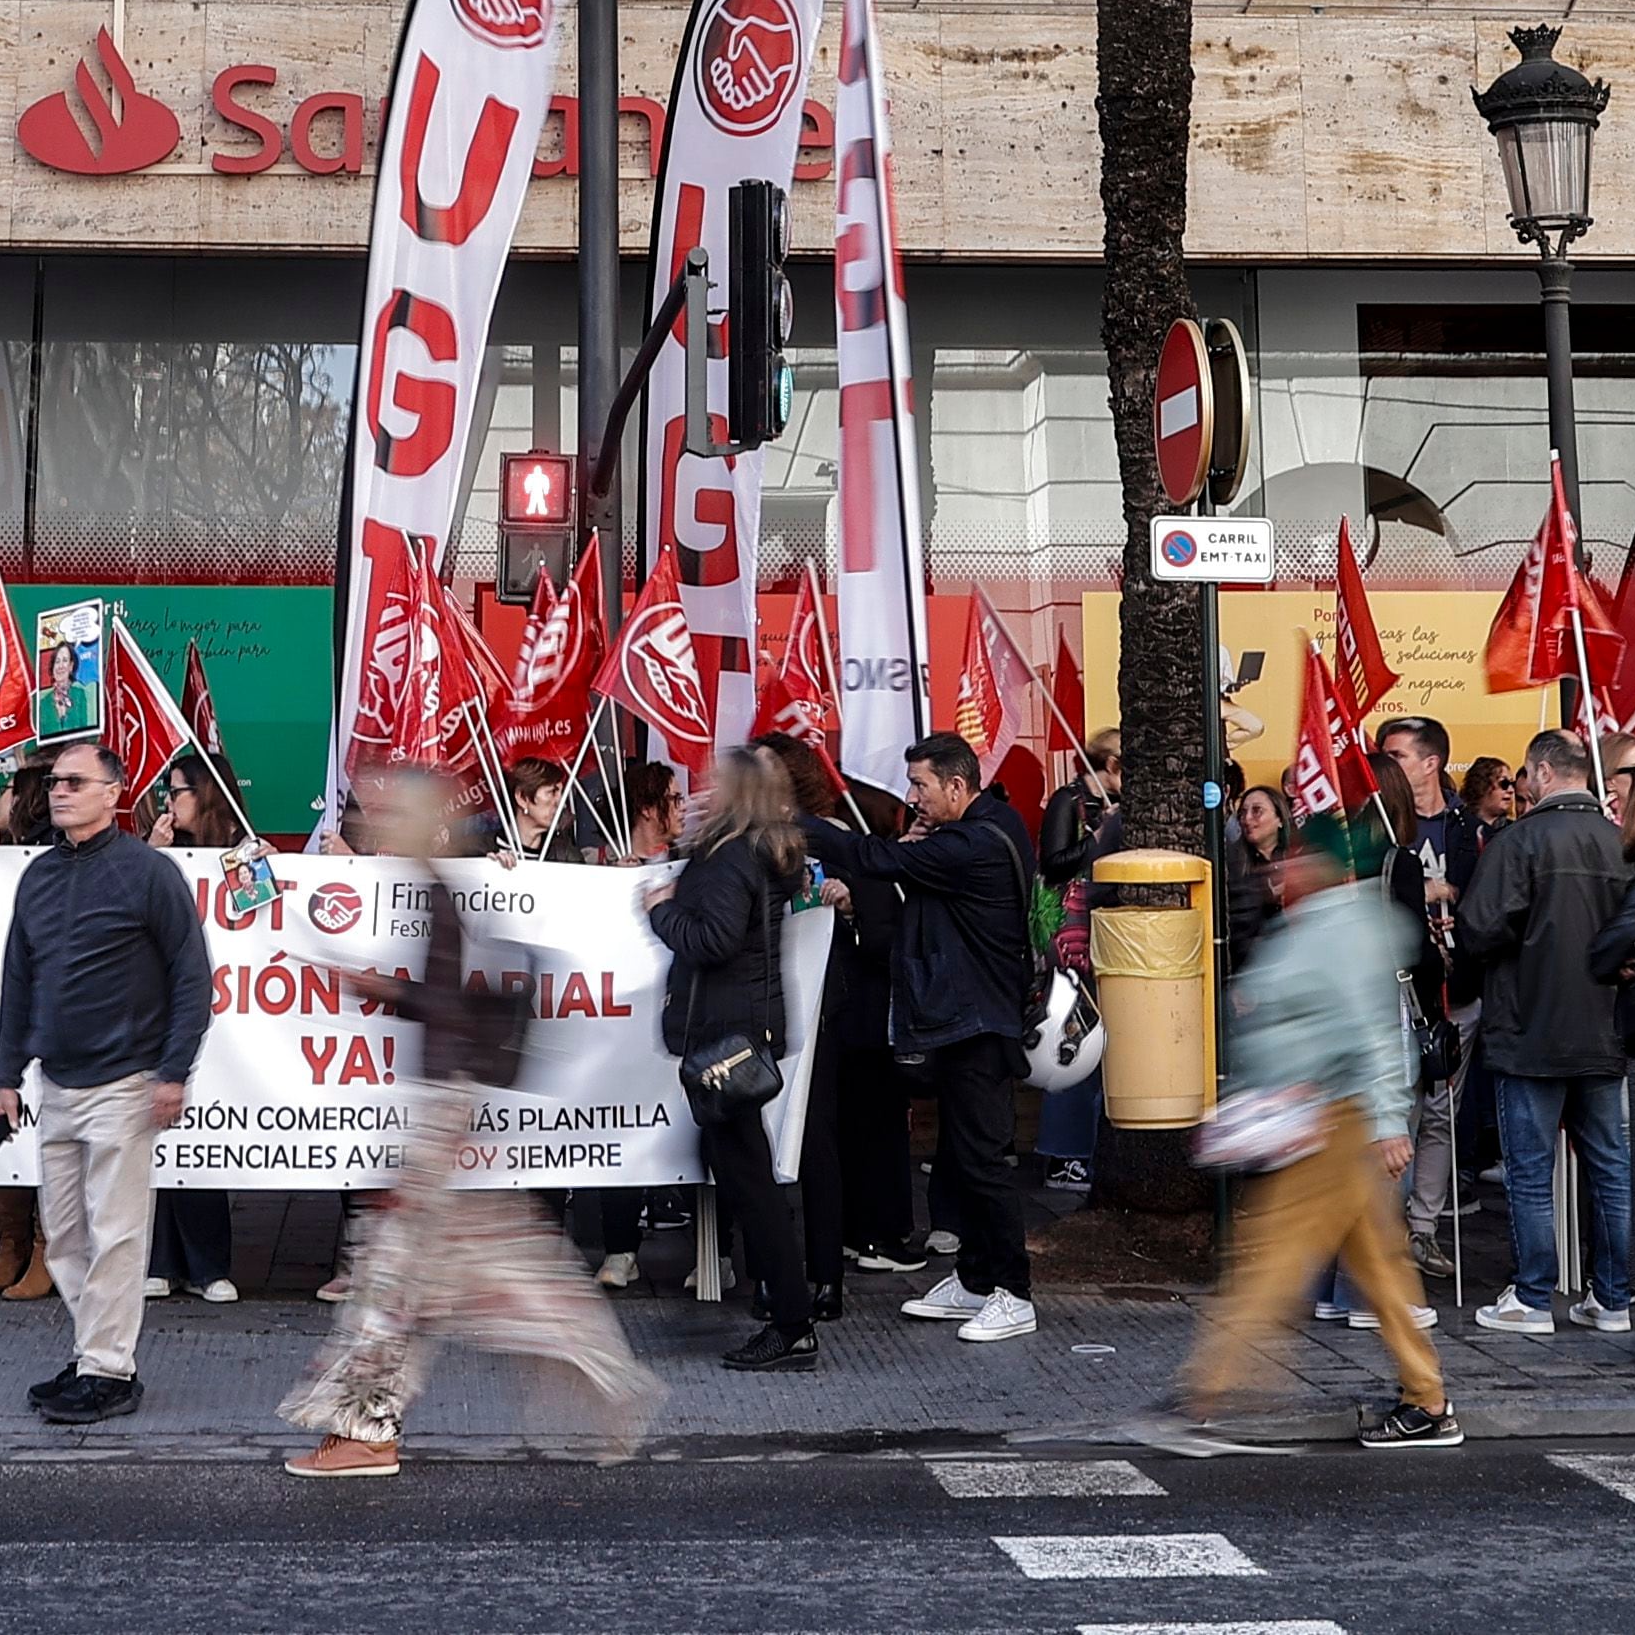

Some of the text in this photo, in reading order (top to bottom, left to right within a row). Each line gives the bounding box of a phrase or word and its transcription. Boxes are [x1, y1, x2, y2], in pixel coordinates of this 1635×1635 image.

[1208, 533, 1258, 544] CARRIL
[178, 620, 222, 643] mejor
[226, 620, 263, 637] para
[1378, 629, 1406, 643] cas
[1411, 625, 1440, 643] las
[236, 641, 272, 664] para
[1397, 645, 1479, 665] soluciones
[1407, 677, 1466, 706] negocio,
[1371, 700, 1409, 713] eros.
[391, 882, 536, 915] Finnciero
[212, 950, 340, 1016] SIÓN
[300, 1036, 395, 1086] YA!
[518, 1103, 672, 1133] PLANTILLA
[175, 1144, 338, 1170] ESENCIALES
[453, 1145, 498, 1171] OY
[506, 1143, 623, 1170] SIEMPRE
